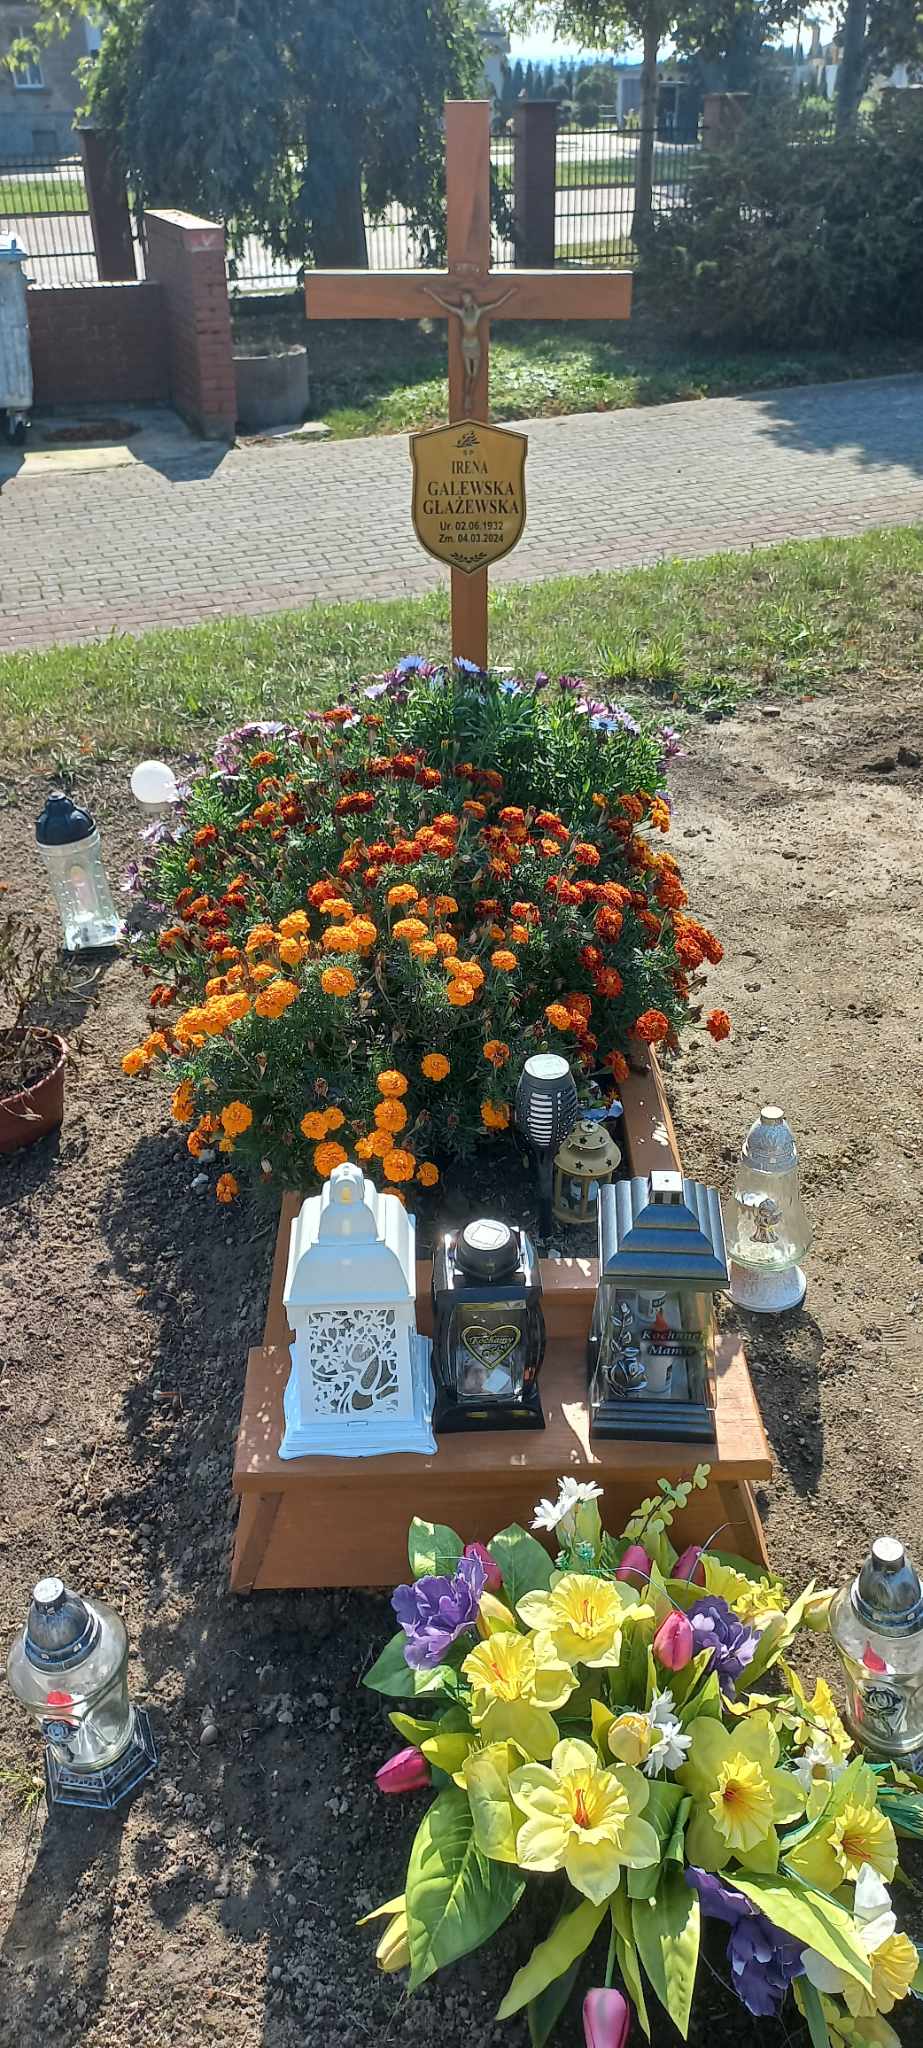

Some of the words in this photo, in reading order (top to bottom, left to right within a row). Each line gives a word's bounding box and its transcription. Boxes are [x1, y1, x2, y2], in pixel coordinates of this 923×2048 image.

[451, 460, 488, 474] IRENA
[427, 480, 515, 496] GALEWSKA
[455, 521, 504, 531] 02.06.1932
[457, 534, 504, 543] 04.03.2024
